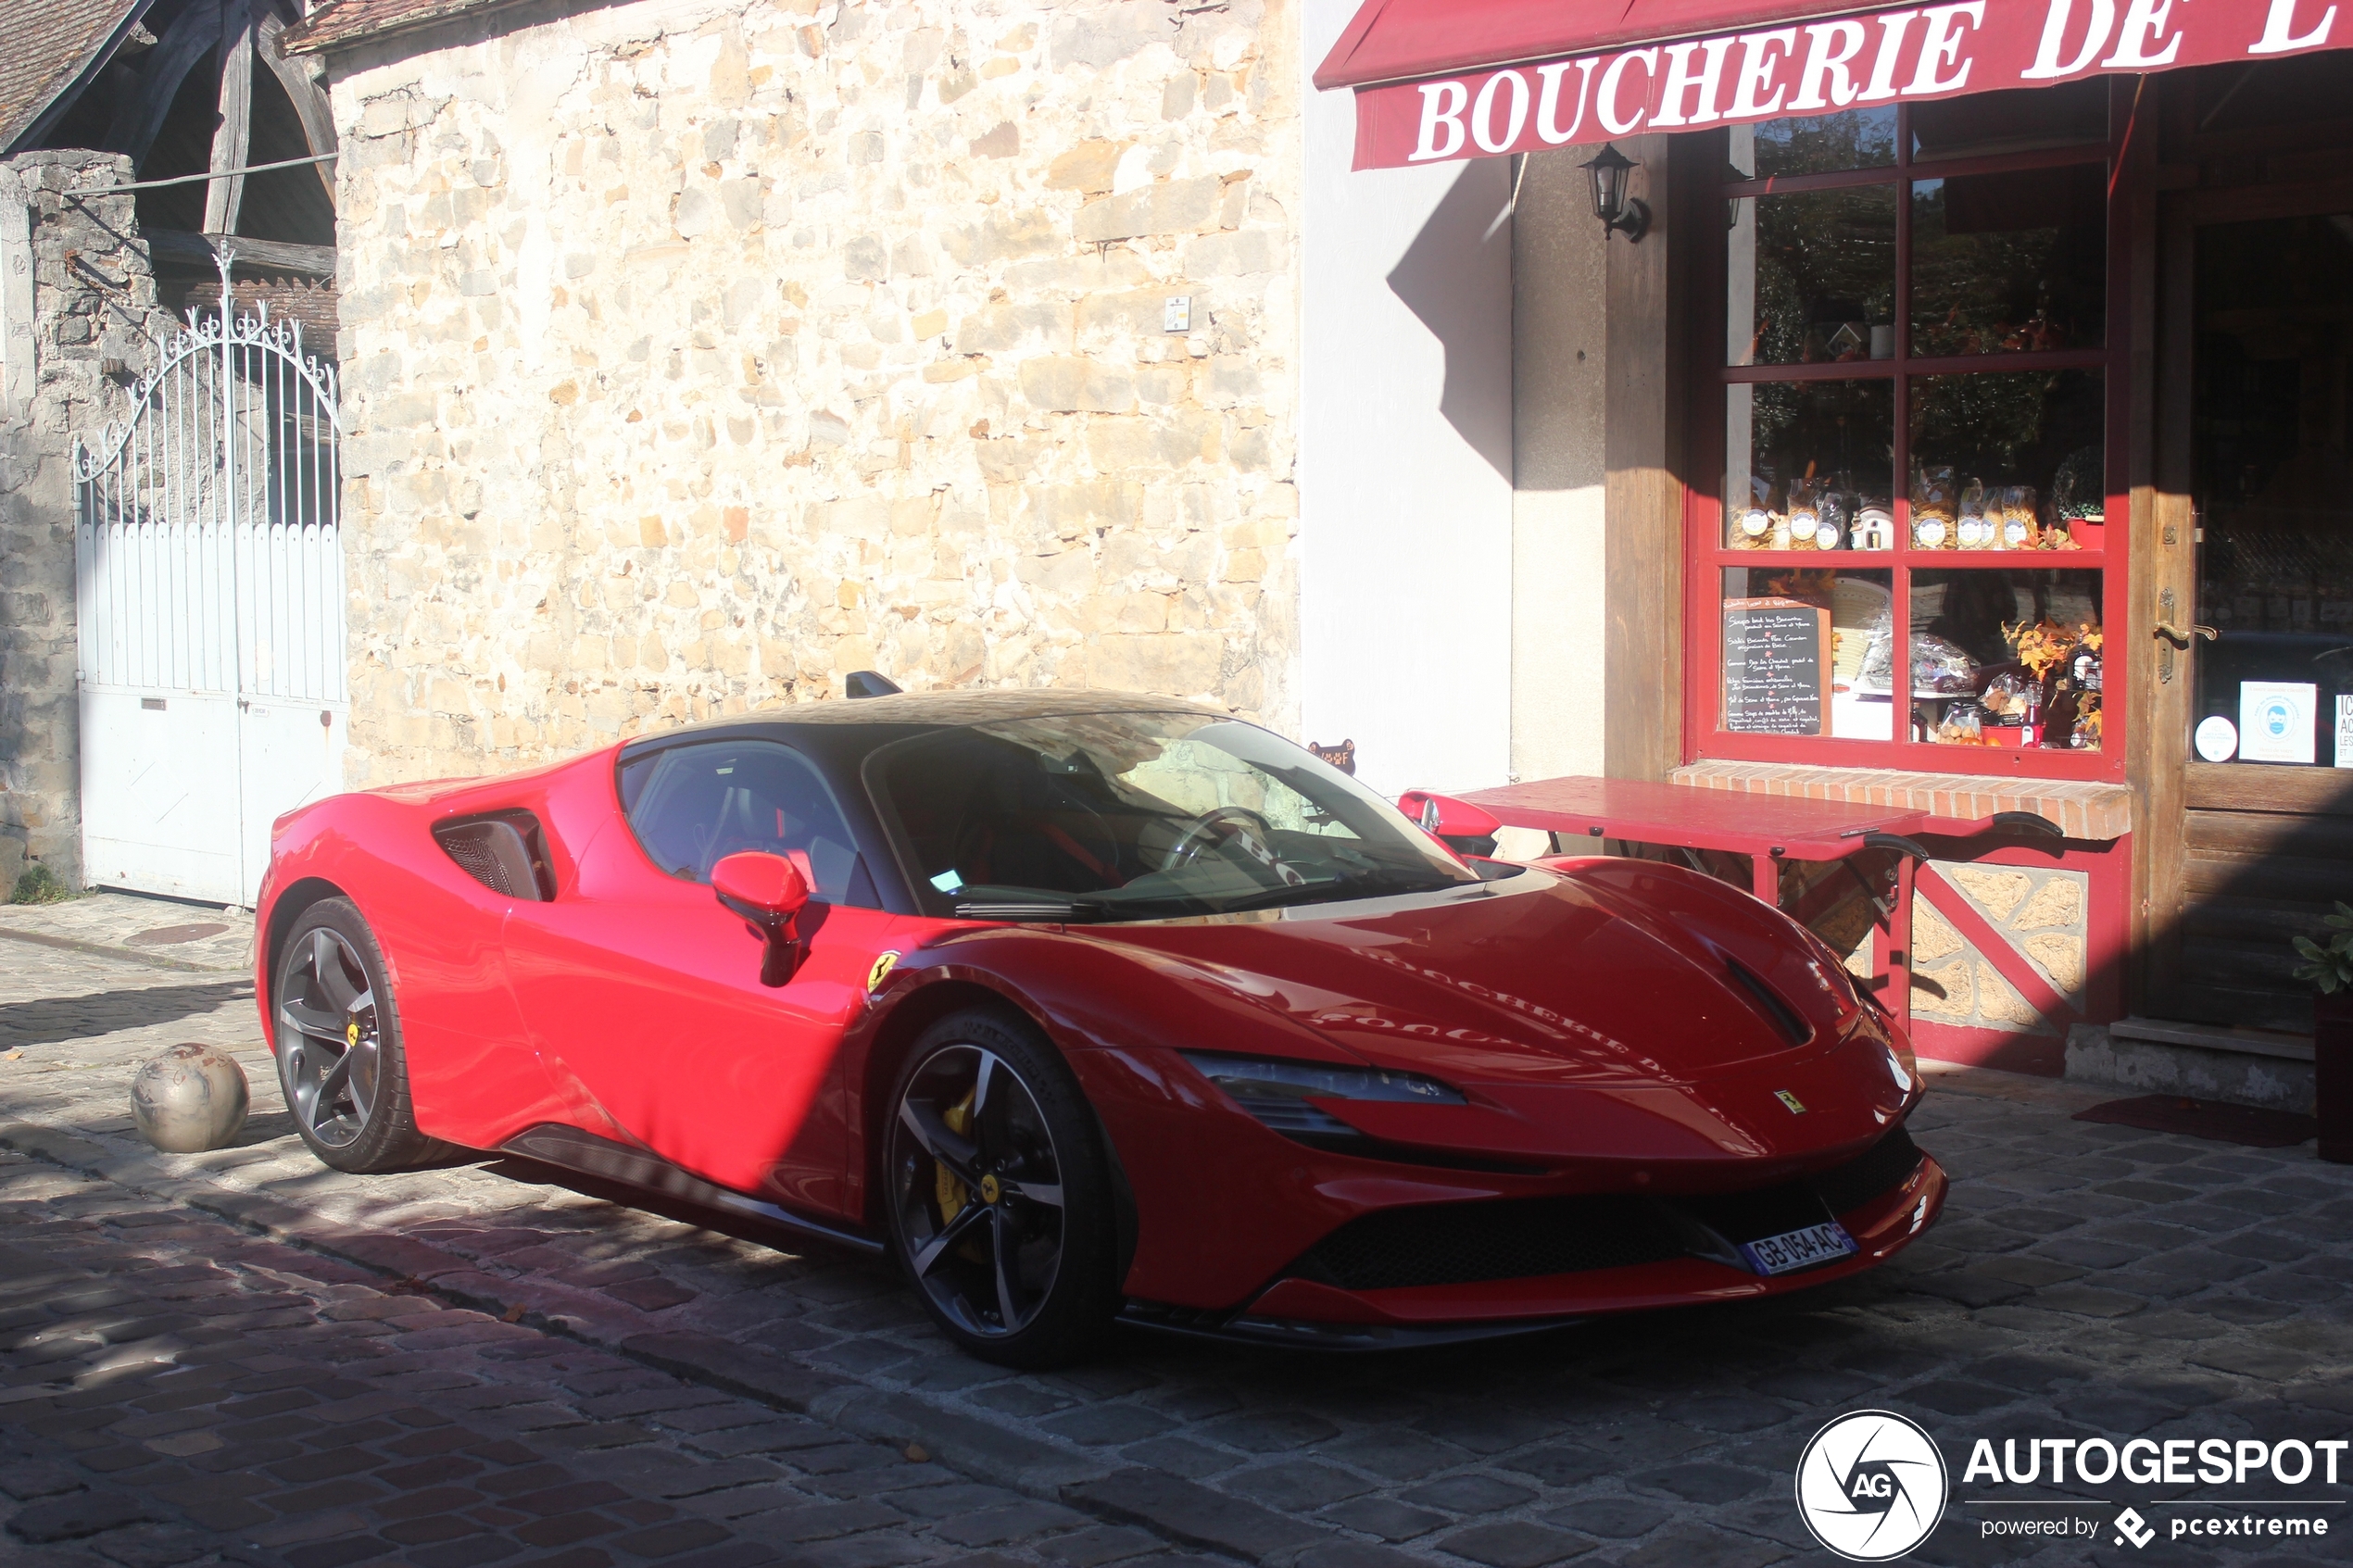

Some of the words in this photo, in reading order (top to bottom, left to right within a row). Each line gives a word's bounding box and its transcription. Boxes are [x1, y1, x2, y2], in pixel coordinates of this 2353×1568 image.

[1407, 0, 1986, 162] BOUCHERIE
[2020, 0, 2183, 79] DE
[1754, 1225, 1843, 1268] GB-054-AC
